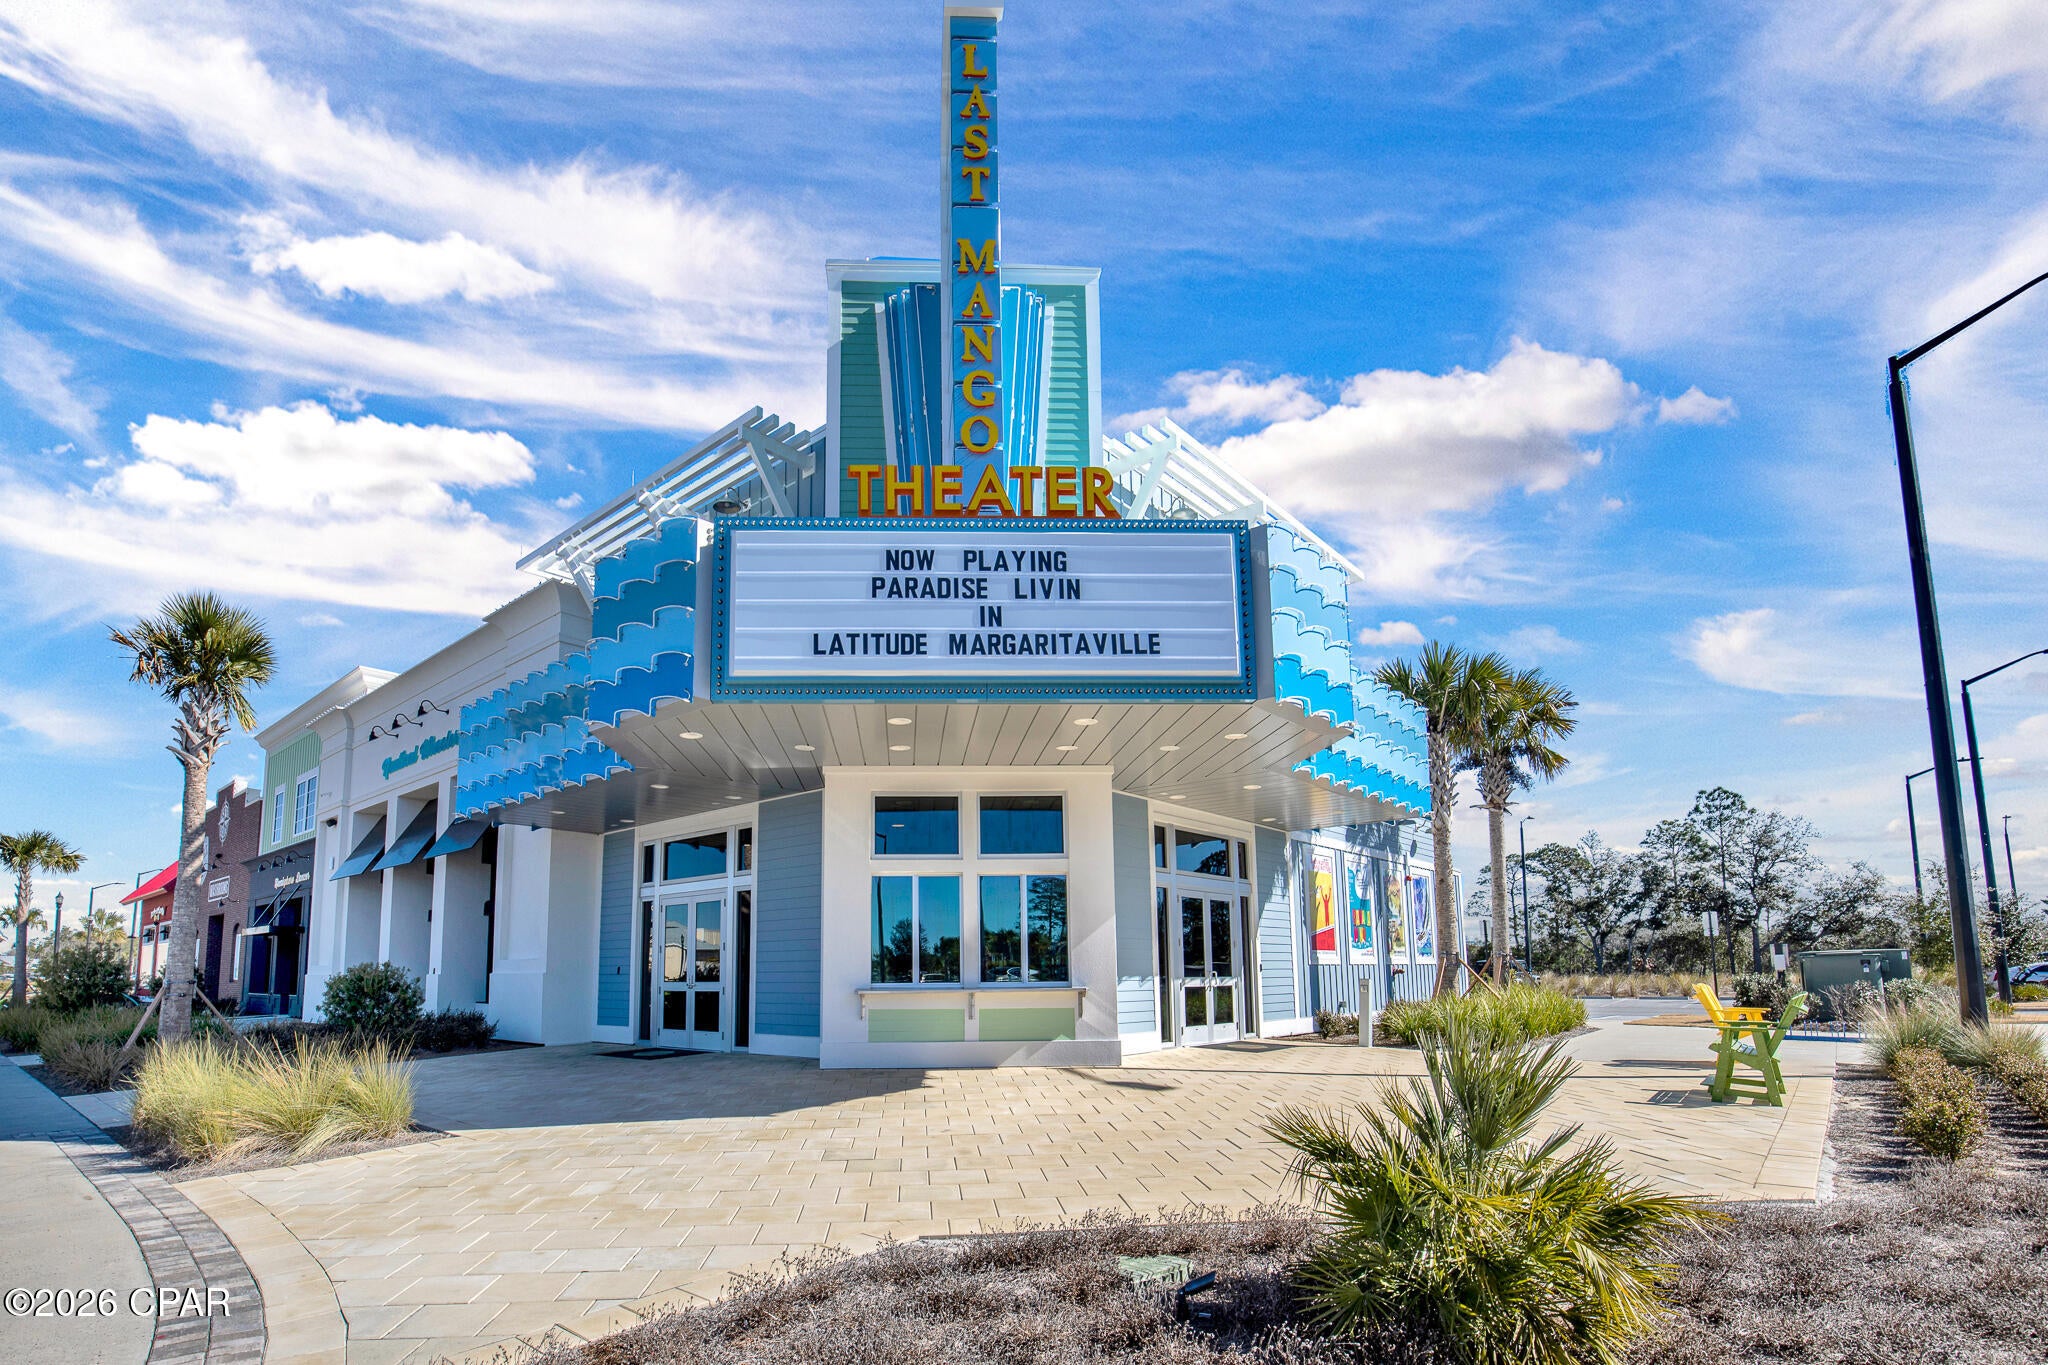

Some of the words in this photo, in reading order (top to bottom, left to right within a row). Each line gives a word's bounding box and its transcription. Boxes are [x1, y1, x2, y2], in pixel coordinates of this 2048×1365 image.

[960, 43, 991, 202] LAST
[957, 238, 998, 454] MANGO
[847, 463, 1122, 519] THEATER
[885, 549, 935, 571] NOW
[963, 549, 1068, 572] PLAYING
[871, 577, 988, 600] PARADISE
[1014, 577, 1081, 600] LIVIN
[979, 605, 1003, 628] IN
[813, 633, 928, 656] LATITUDE
[948, 633, 1161, 656] MARGARITAVILLE
